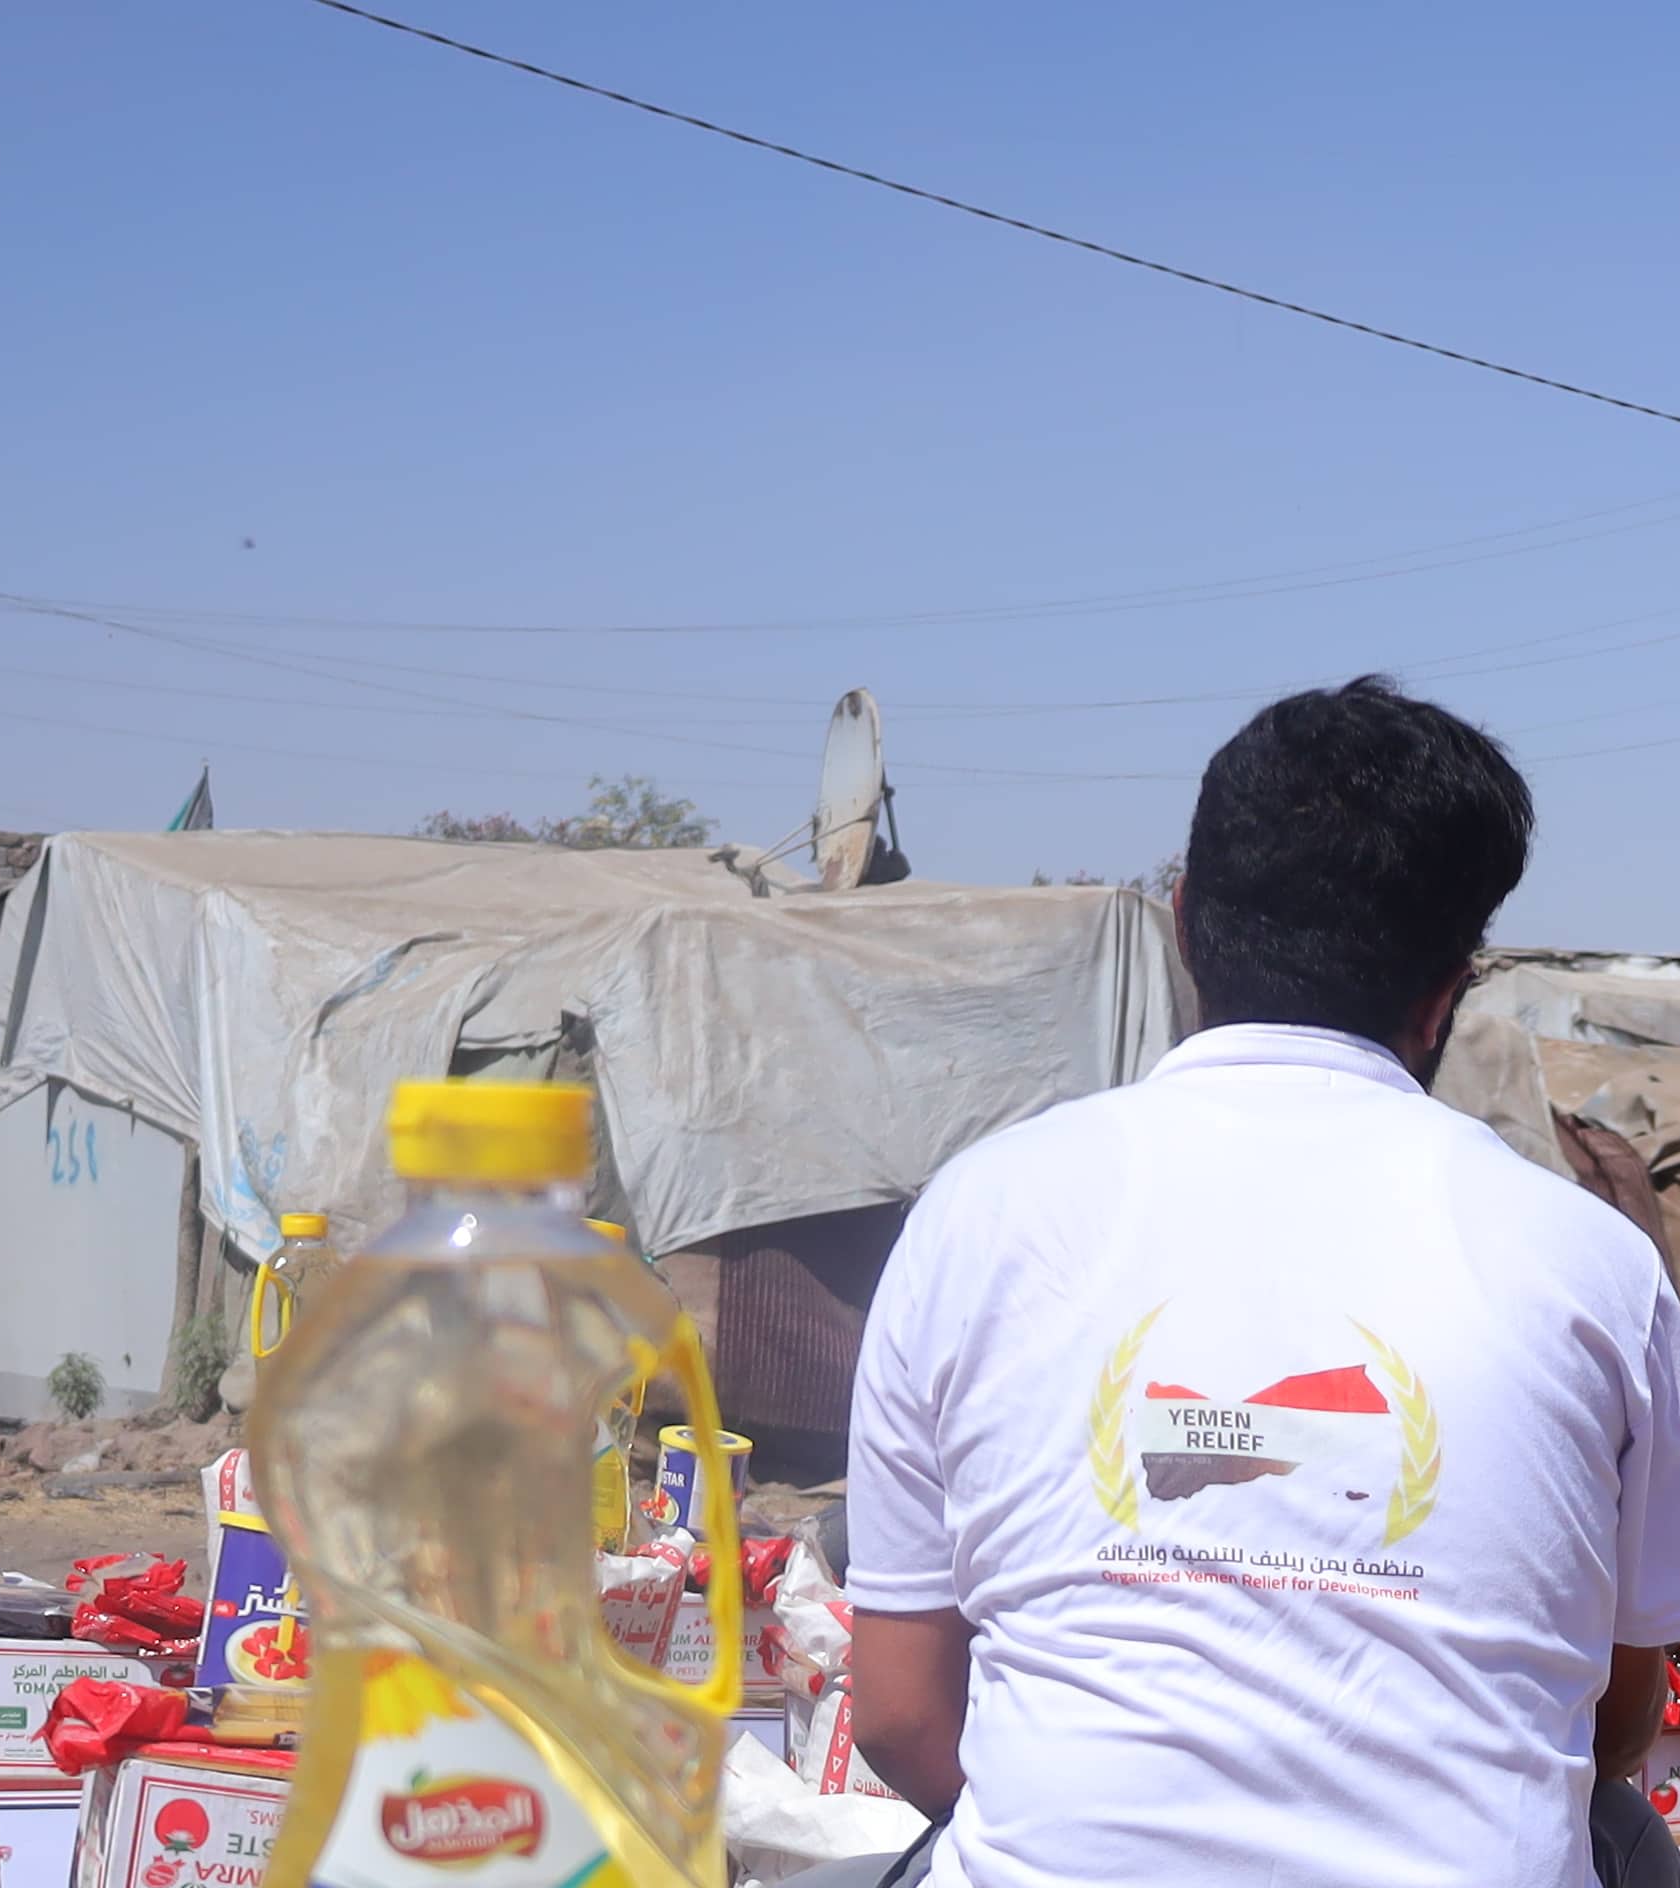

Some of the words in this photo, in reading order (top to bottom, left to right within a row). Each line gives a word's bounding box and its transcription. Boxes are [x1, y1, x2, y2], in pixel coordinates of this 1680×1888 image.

[1169, 1408, 1251, 1429] YEMEN
[1186, 1431, 1264, 1452] RELIEF
[1171, 1544, 1243, 1567] للتنمية
[1250, 1547, 1304, 1573] ريليف
[1310, 1555, 1348, 1577] يمن
[1353, 1558, 1424, 1578] منظمة
[1101, 1569, 1181, 1588] Organized
[1184, 1570, 1238, 1585] Yemen
[1241, 1572, 1287, 1589] Relief
[1290, 1575, 1315, 1592] for
[1318, 1576, 1420, 1602] Development
[12, 1665, 47, 1679] المركز
[51, 1665, 108, 1680] الطماطم
